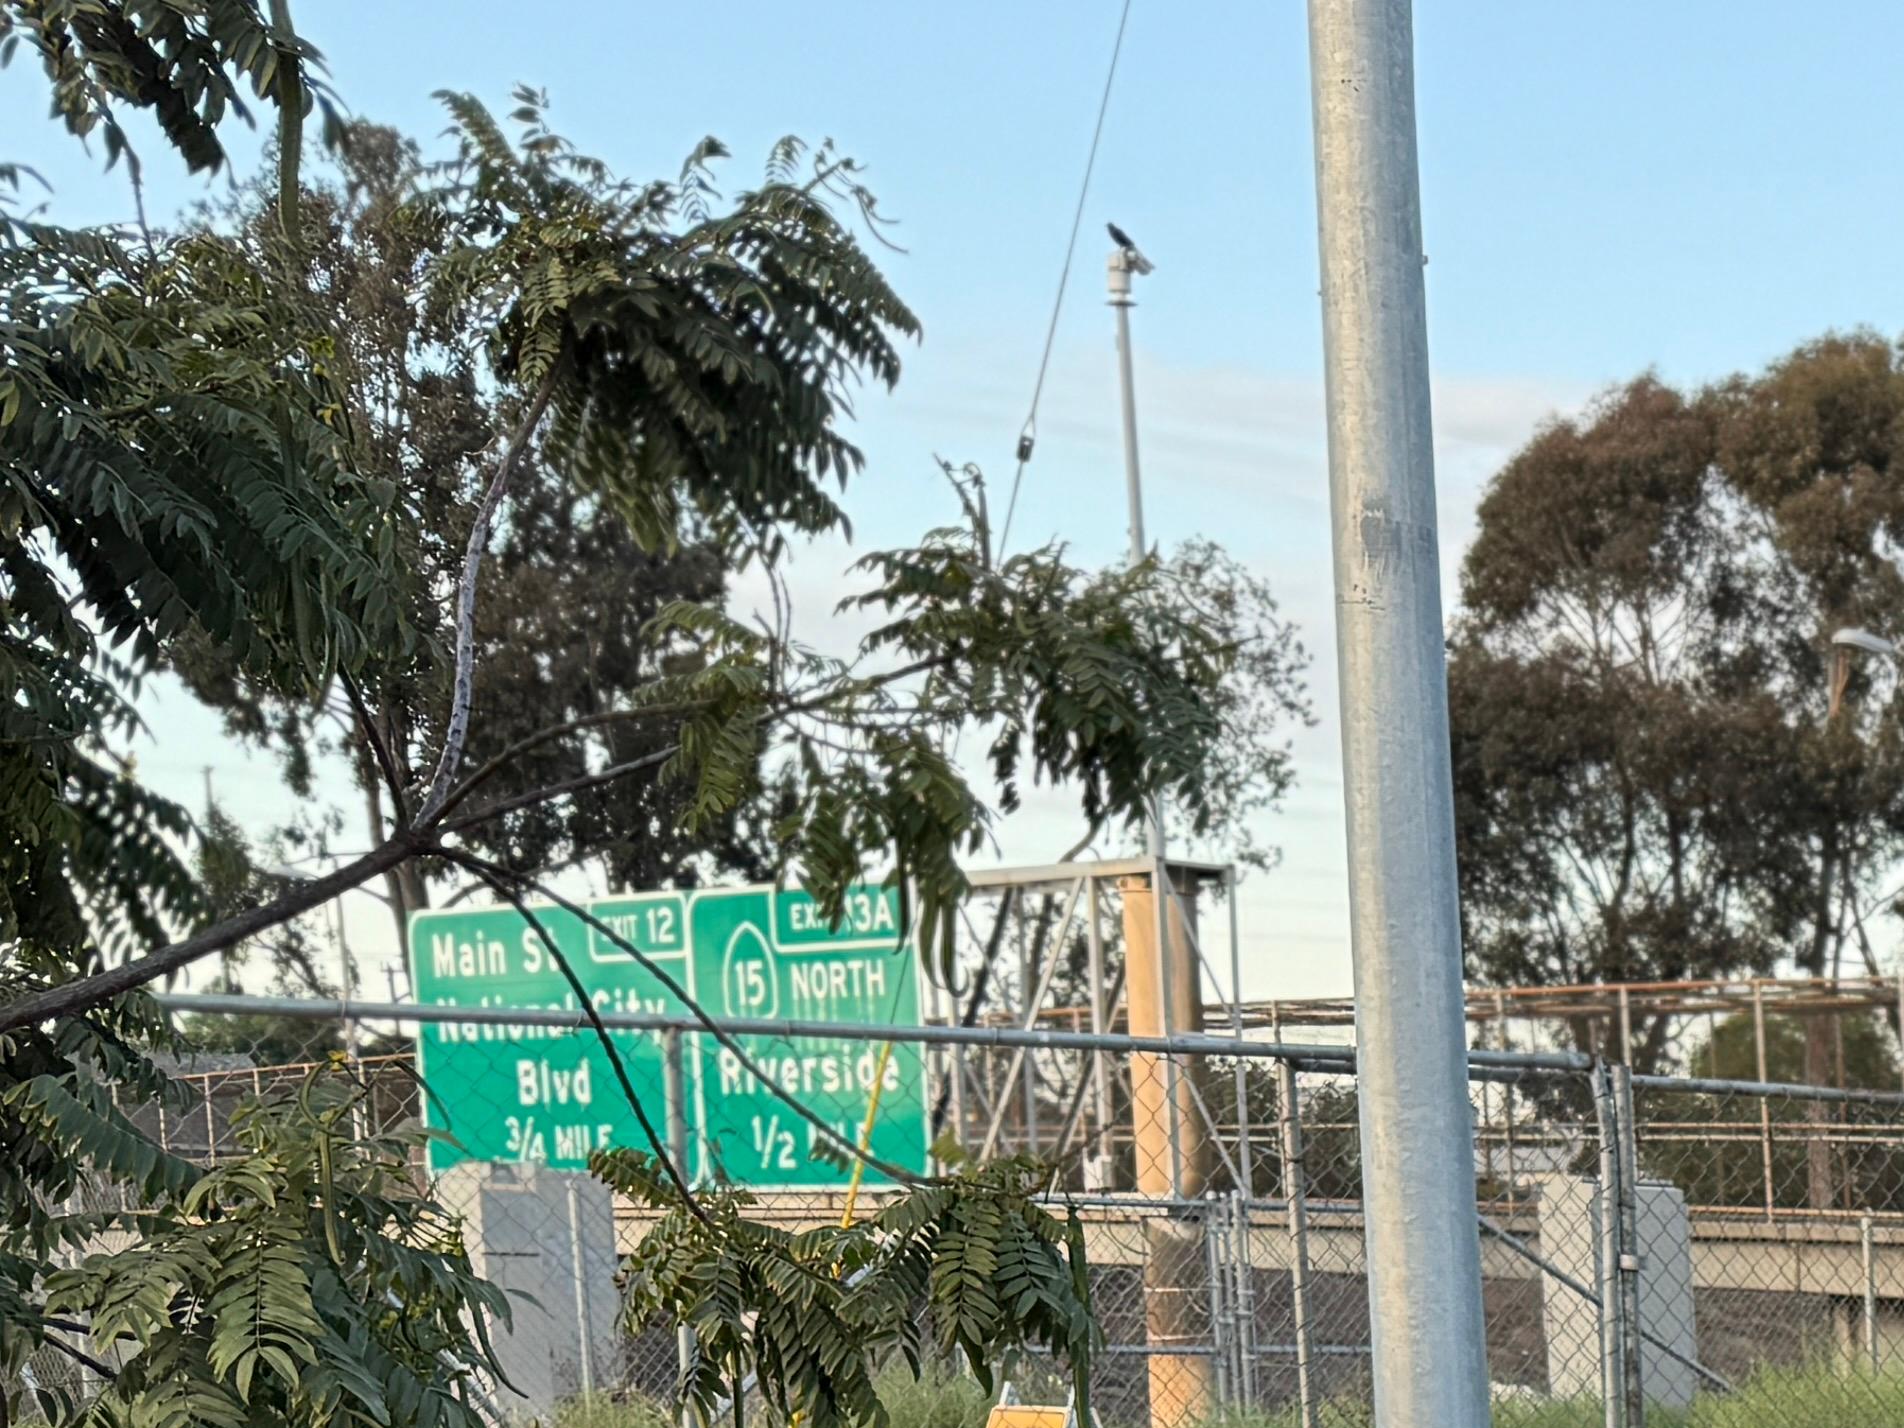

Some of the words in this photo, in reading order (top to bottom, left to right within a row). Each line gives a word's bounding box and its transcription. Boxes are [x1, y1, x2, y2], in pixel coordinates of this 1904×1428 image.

[646, 906, 675, 944] 12
[432, 931, 507, 978] Main
[735, 959, 766, 1007] 15
[790, 959, 886, 1000] NORTH
[517, 1056, 592, 1106] Blvd
[719, 1044, 899, 1095] Riverside
[752, 1115, 797, 1169] 1/2
